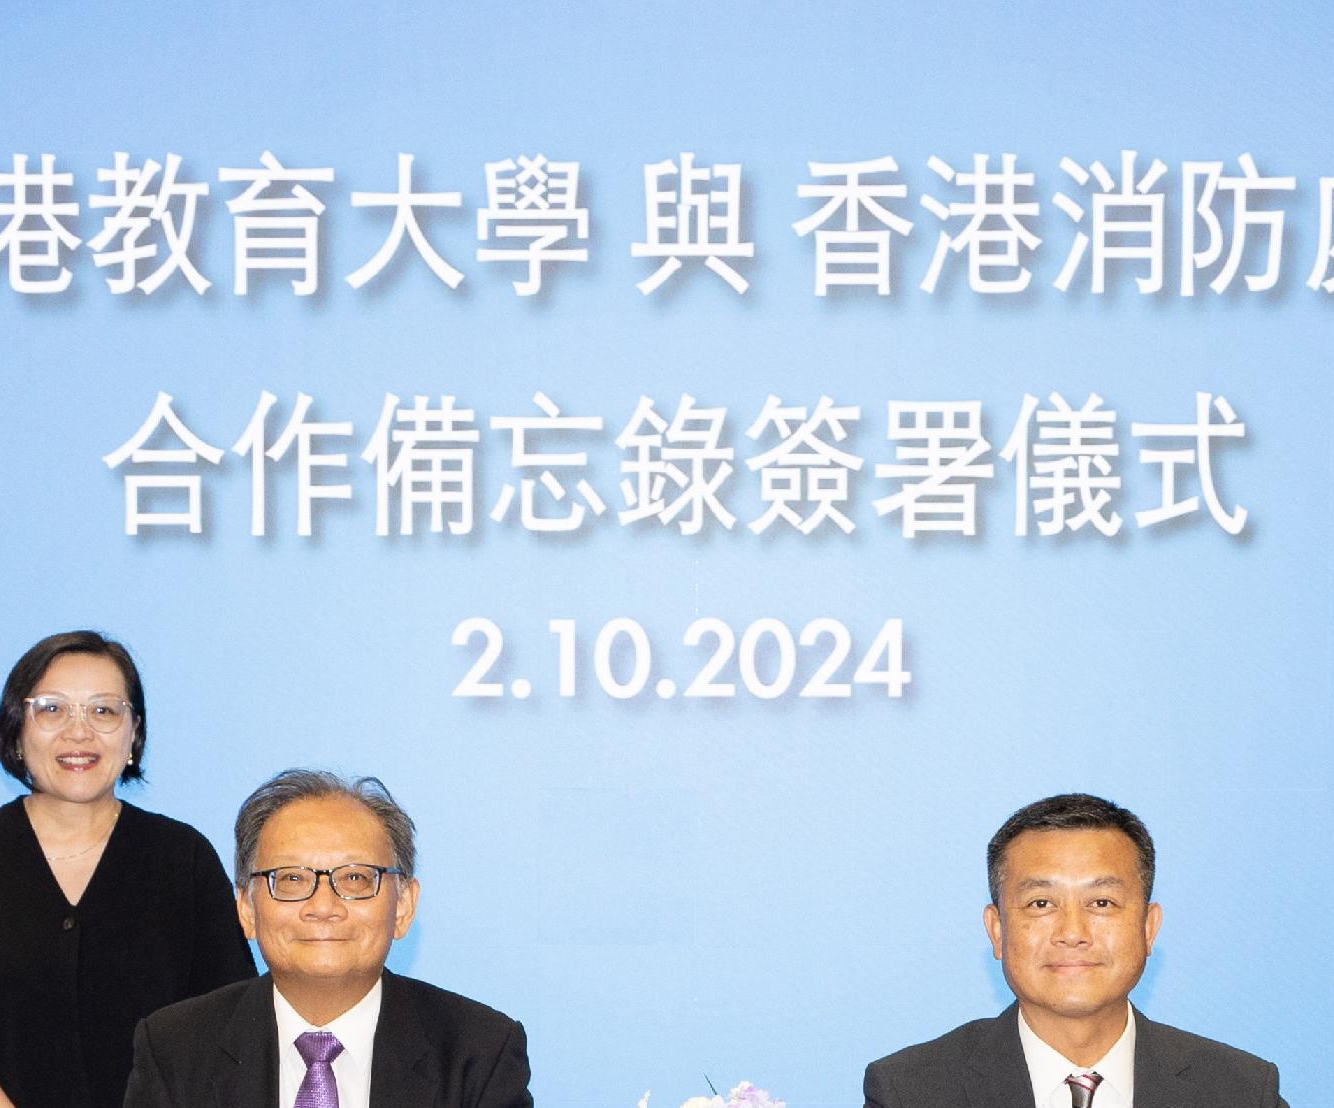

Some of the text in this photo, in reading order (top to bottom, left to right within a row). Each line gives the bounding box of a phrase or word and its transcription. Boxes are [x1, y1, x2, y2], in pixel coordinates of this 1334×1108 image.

[630, 152, 755, 296] 與
[104, 392, 1249, 540] 合作備忘錄簽署儀式
[452, 618, 911, 699] 2.10.2024
